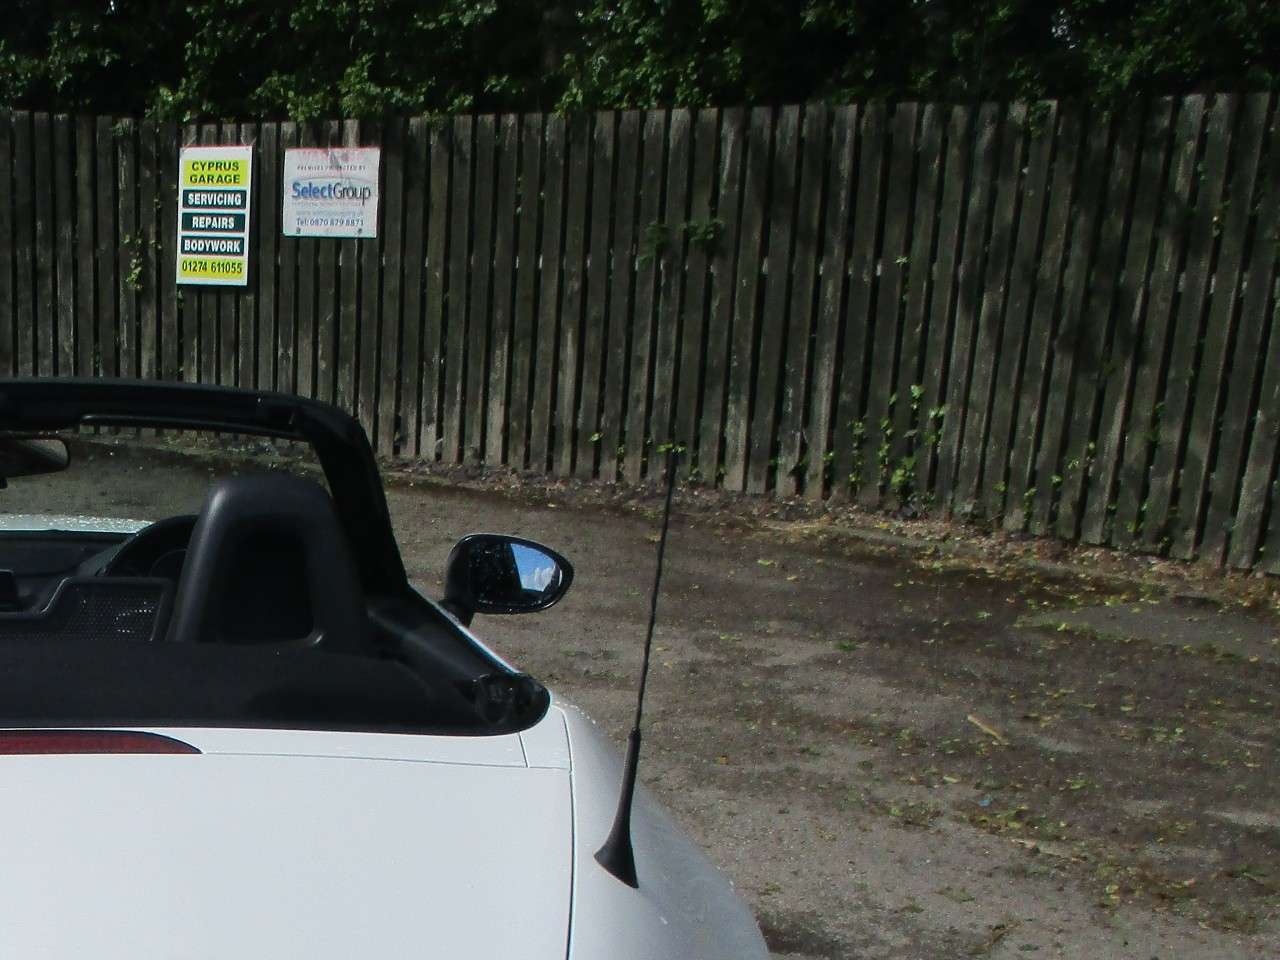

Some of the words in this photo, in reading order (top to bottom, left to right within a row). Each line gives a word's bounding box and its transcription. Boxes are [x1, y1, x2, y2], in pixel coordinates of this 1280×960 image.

[191, 161, 239, 172] CYPRUS
[189, 174, 240, 184] GARAGE
[187, 193, 241, 206] SERVICING
[291, 181, 372, 206] SelectGroup
[192, 216, 235, 229] REPAIRS
[184, 239, 240, 253] BODYWORK
[182, 261, 207, 272] 01274
[211, 262, 242, 274] 611055
